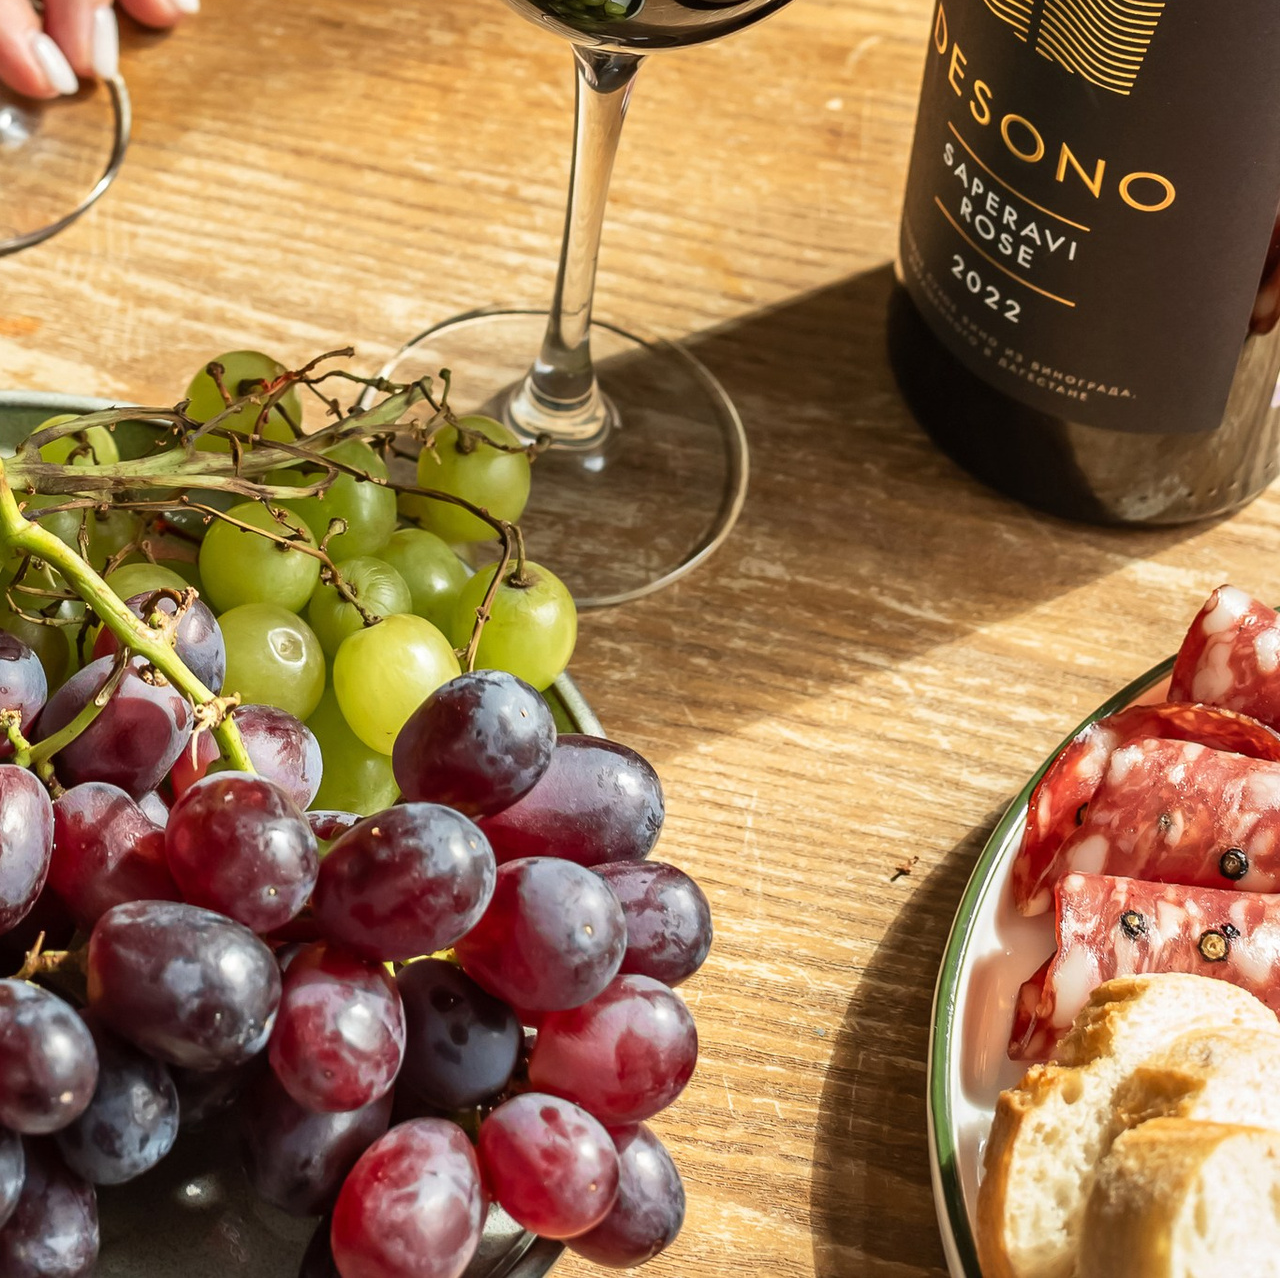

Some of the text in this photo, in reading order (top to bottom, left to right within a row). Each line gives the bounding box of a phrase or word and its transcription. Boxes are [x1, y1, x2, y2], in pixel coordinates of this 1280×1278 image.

[933, 1, 1177, 212] DESONO
[942, 142, 1077, 261] SAPERAVI
[959, 195, 1035, 269] ROSE
[950, 253, 1022, 323] 2022
